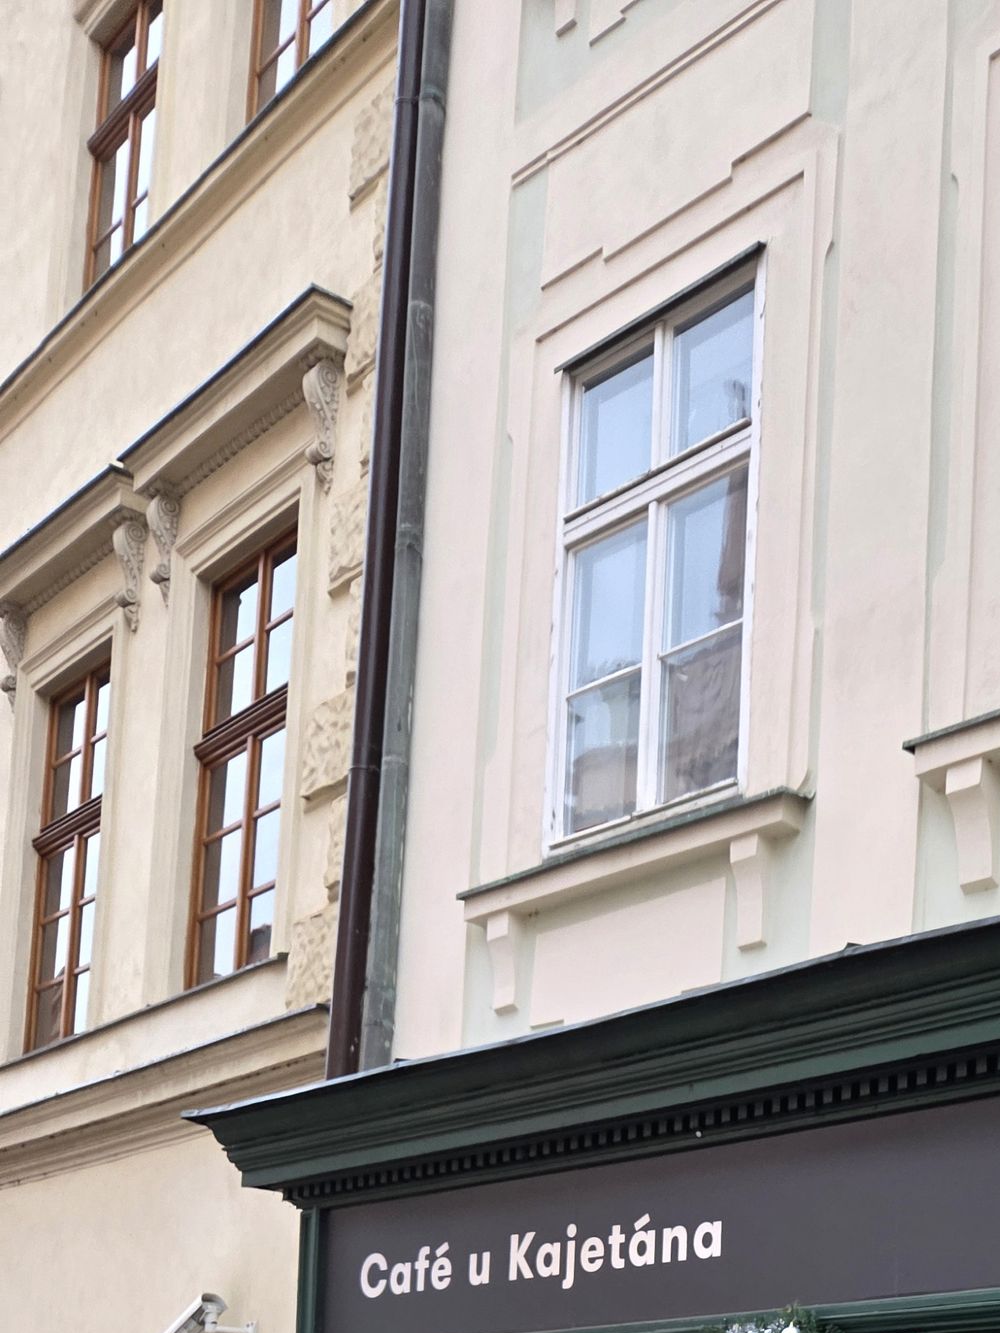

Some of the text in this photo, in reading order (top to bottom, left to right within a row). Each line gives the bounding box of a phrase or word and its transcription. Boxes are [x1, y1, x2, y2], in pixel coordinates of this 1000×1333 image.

[360, 1212, 723, 1299] Café u Kajetána
